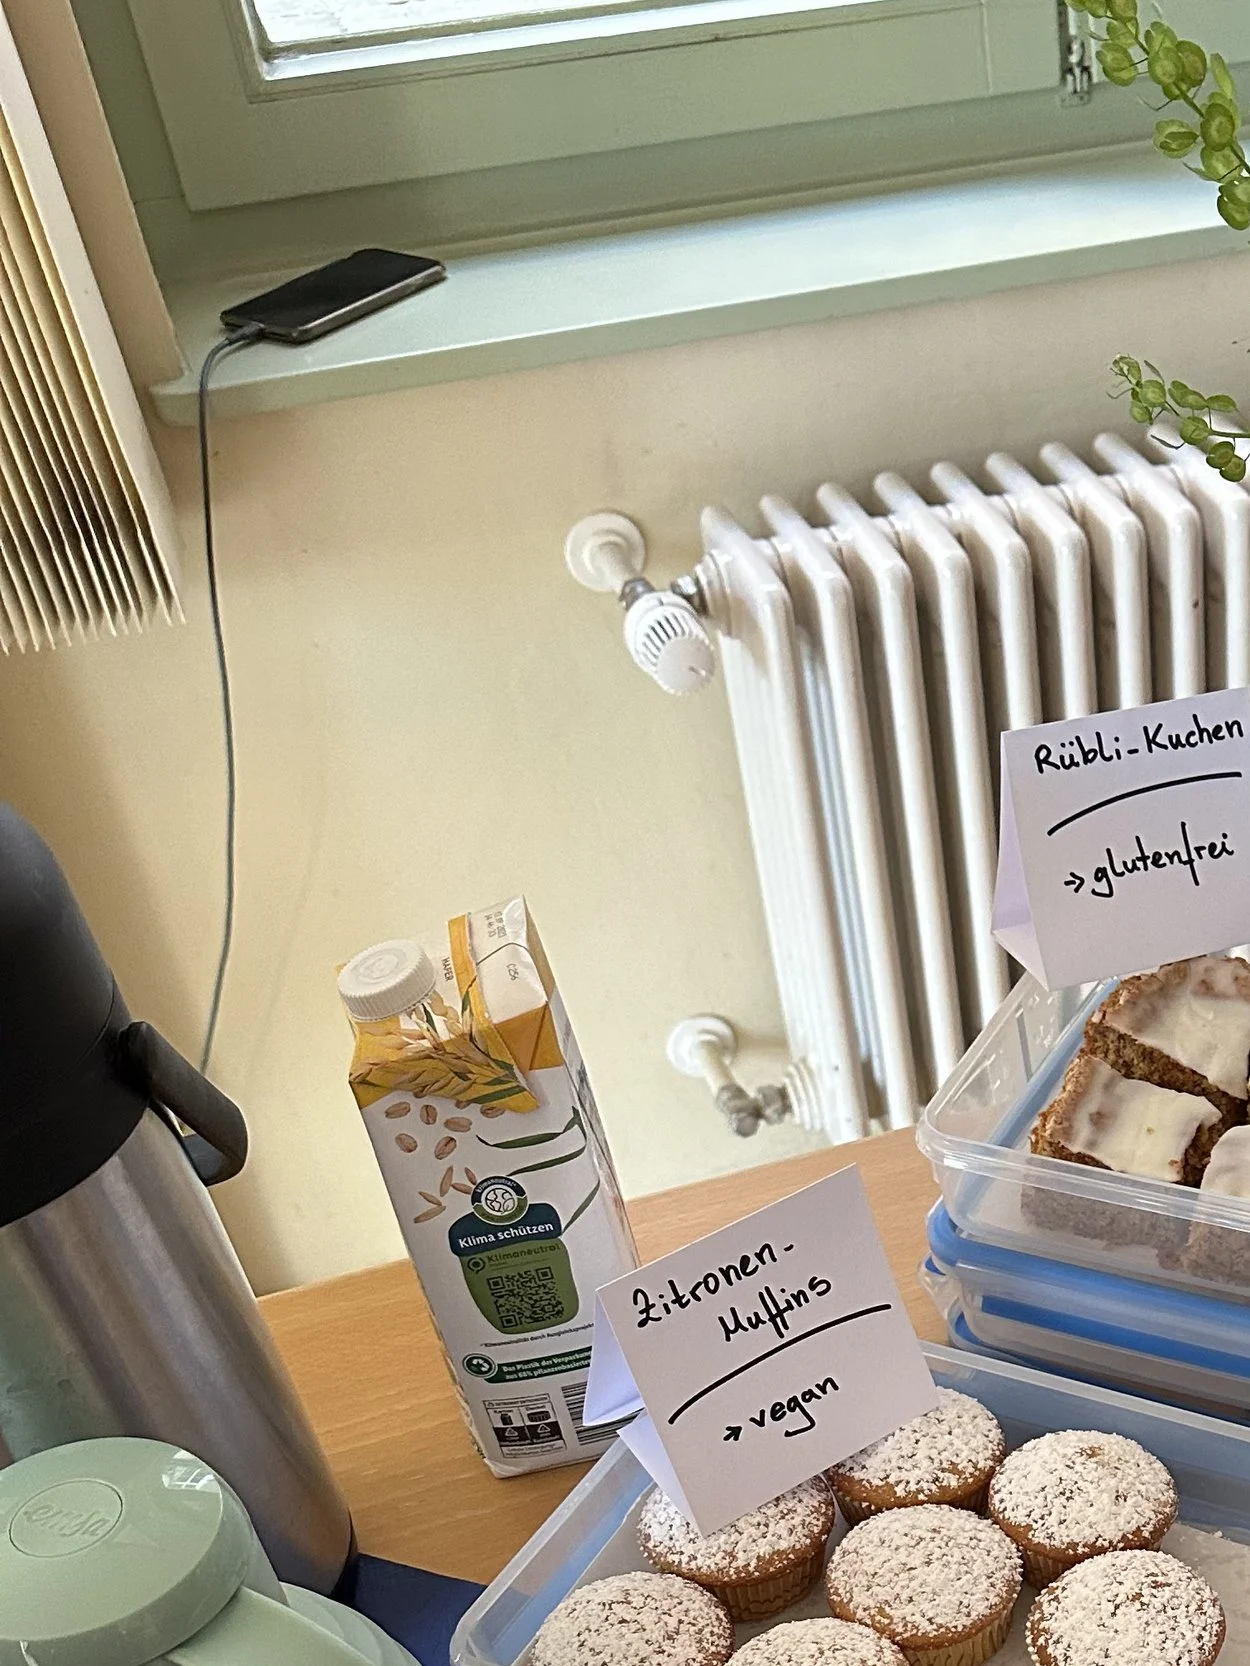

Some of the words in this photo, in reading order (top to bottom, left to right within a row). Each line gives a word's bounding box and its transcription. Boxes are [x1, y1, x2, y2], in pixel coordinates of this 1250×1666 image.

[1034, 714, 1244, 773] Rübli-Kuchen
[1091, 821, 1235, 898] glutenfrei
[441, 956, 454, 981] HAFER
[458, 1233, 496, 1249] Klima
[497, 1223, 555, 1241] schützen
[486, 1243, 562, 1264] Klimaneutral
[632, 1242, 794, 1328] Zitronen-
[717, 1275, 832, 1342] Muffins
[749, 1376, 840, 1438] vegan
